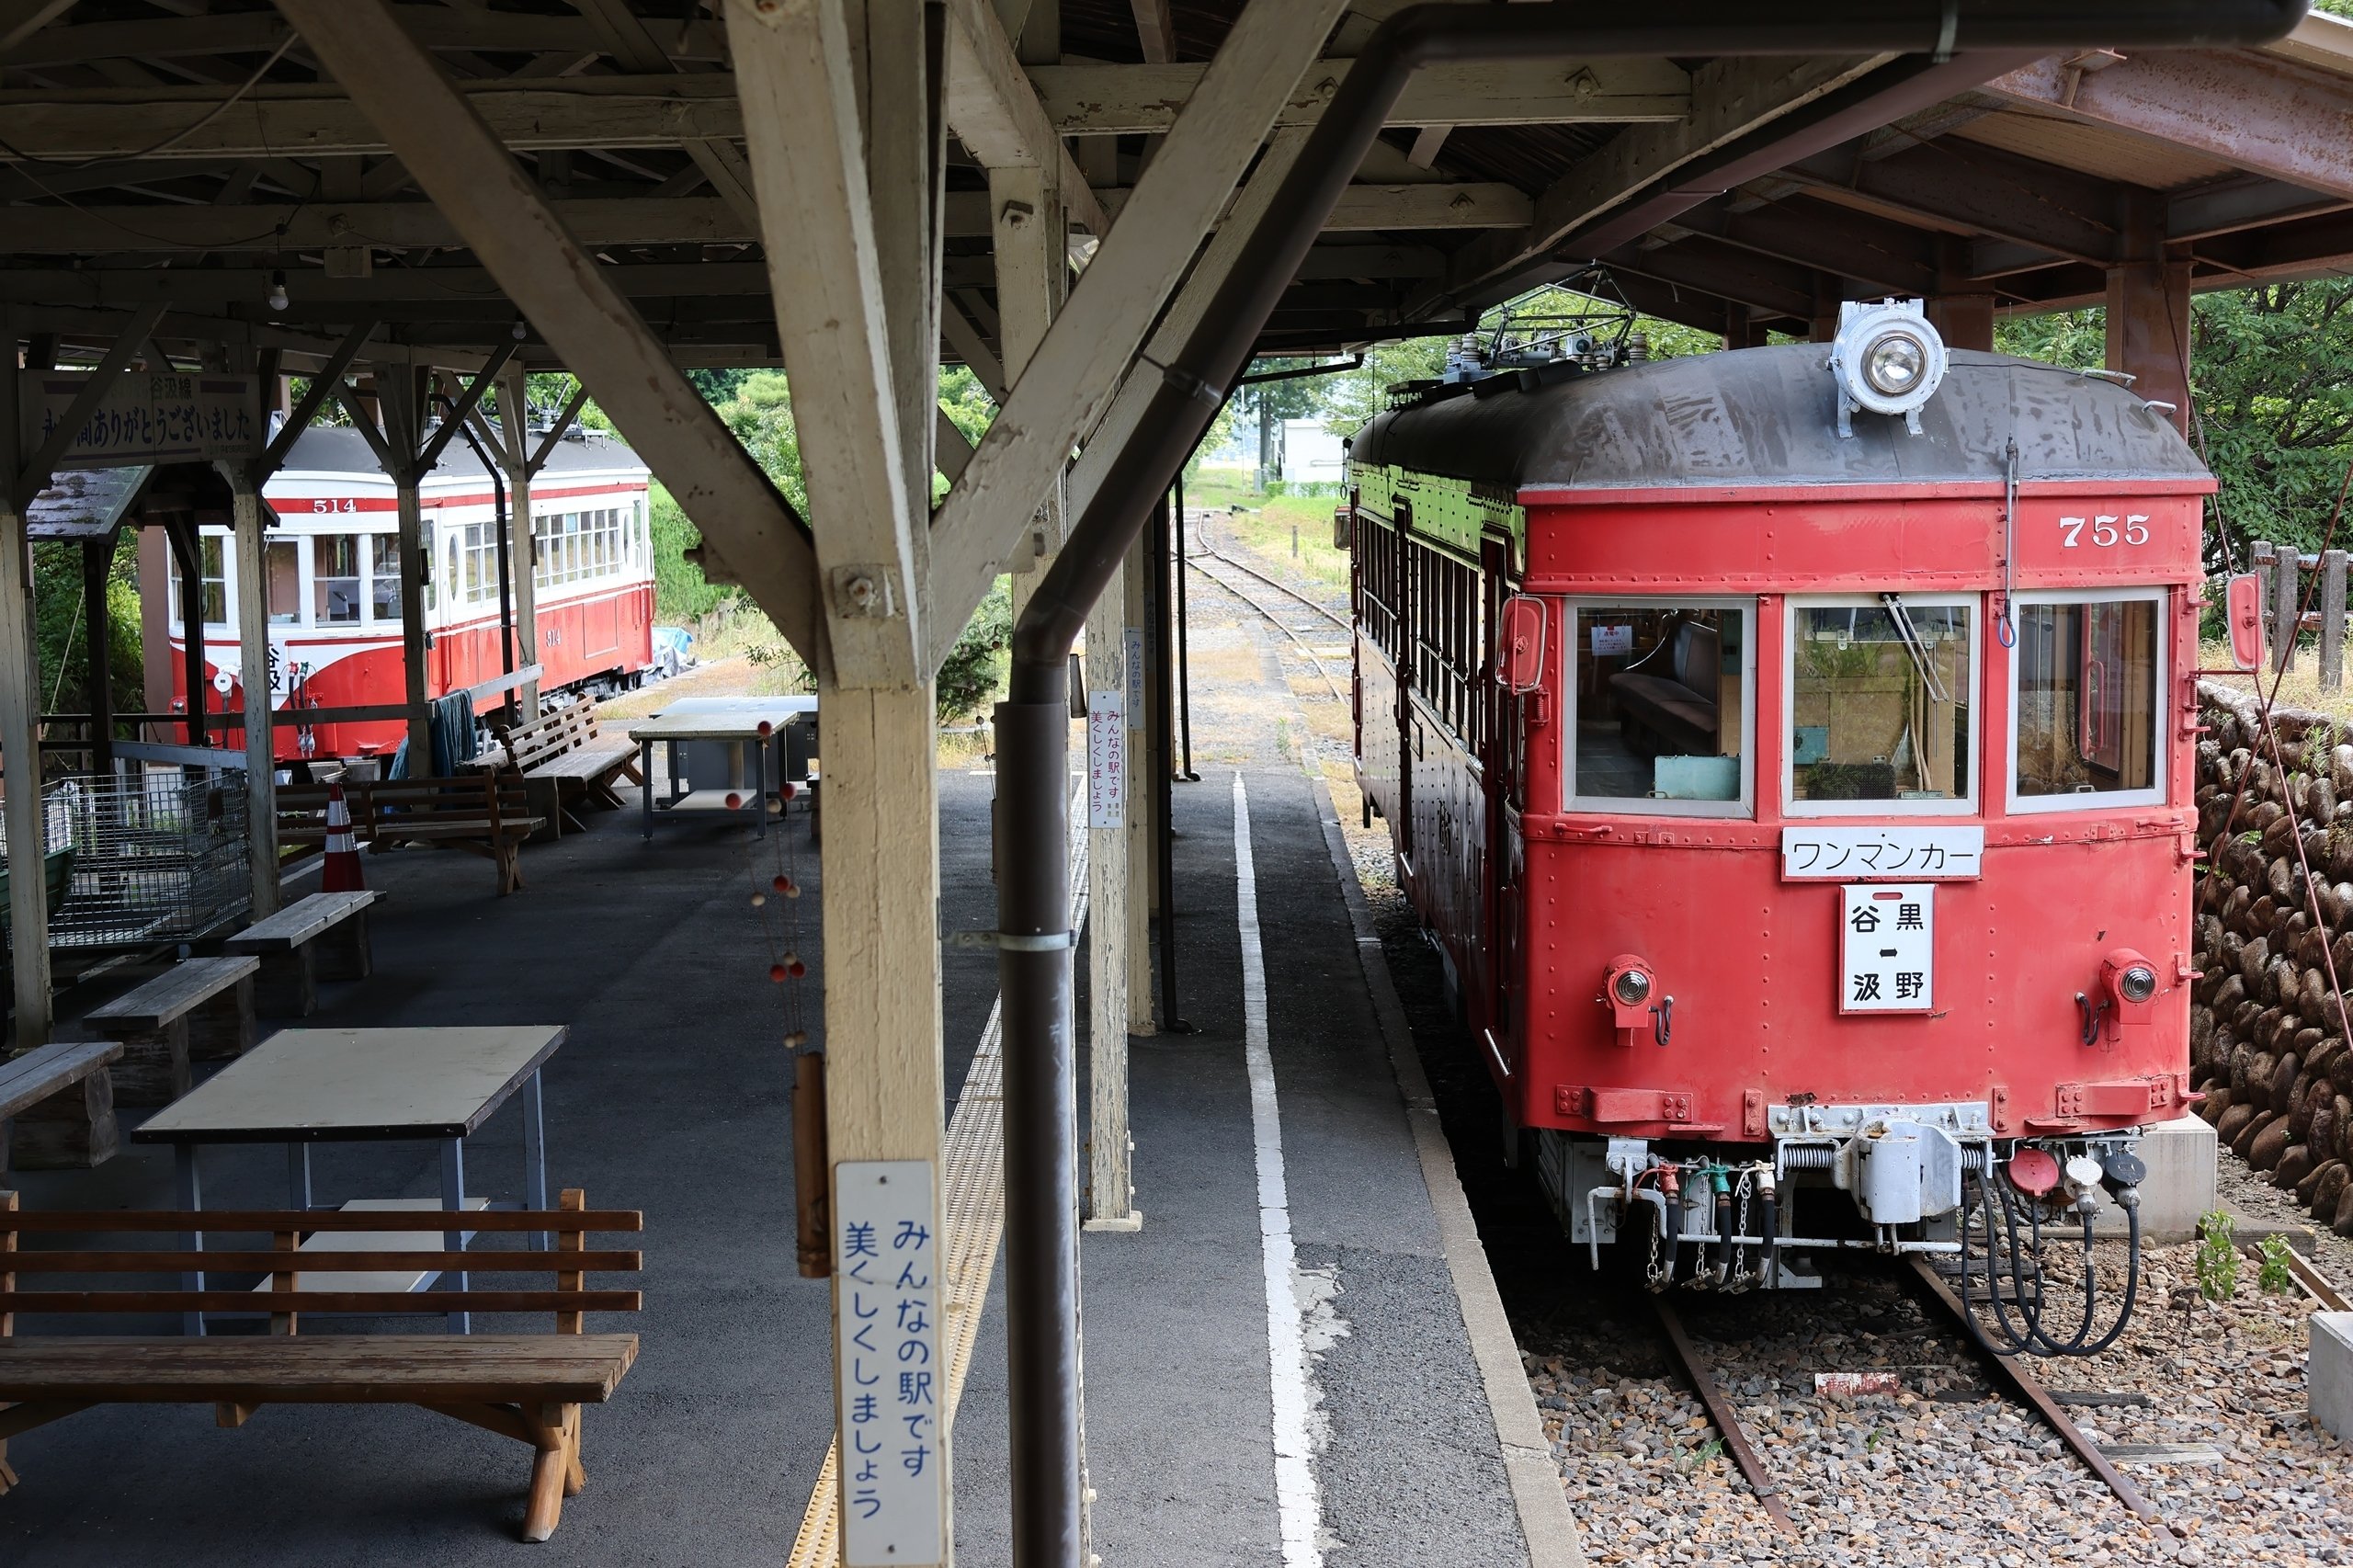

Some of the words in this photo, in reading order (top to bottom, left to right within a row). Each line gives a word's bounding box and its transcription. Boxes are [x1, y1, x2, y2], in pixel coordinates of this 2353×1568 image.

[313, 499, 358, 513] 514
[2059, 515, 2150, 548] 755
[546, 630, 561, 646] 514
[1131, 641, 1141, 707] みんなの駅です
[1090, 710, 1103, 812] 美くしくしましょう
[1107, 710, 1120, 799] みんなの駅です
[1793, 843, 1974, 870] ワンマンカー
[1850, 905, 1881, 1002] 谷汲
[1896, 903, 1924, 999] 黒野
[845, 1221, 881, 1519] 美くしくしましょう
[893, 1220, 933, 1477] みんなの駅です
